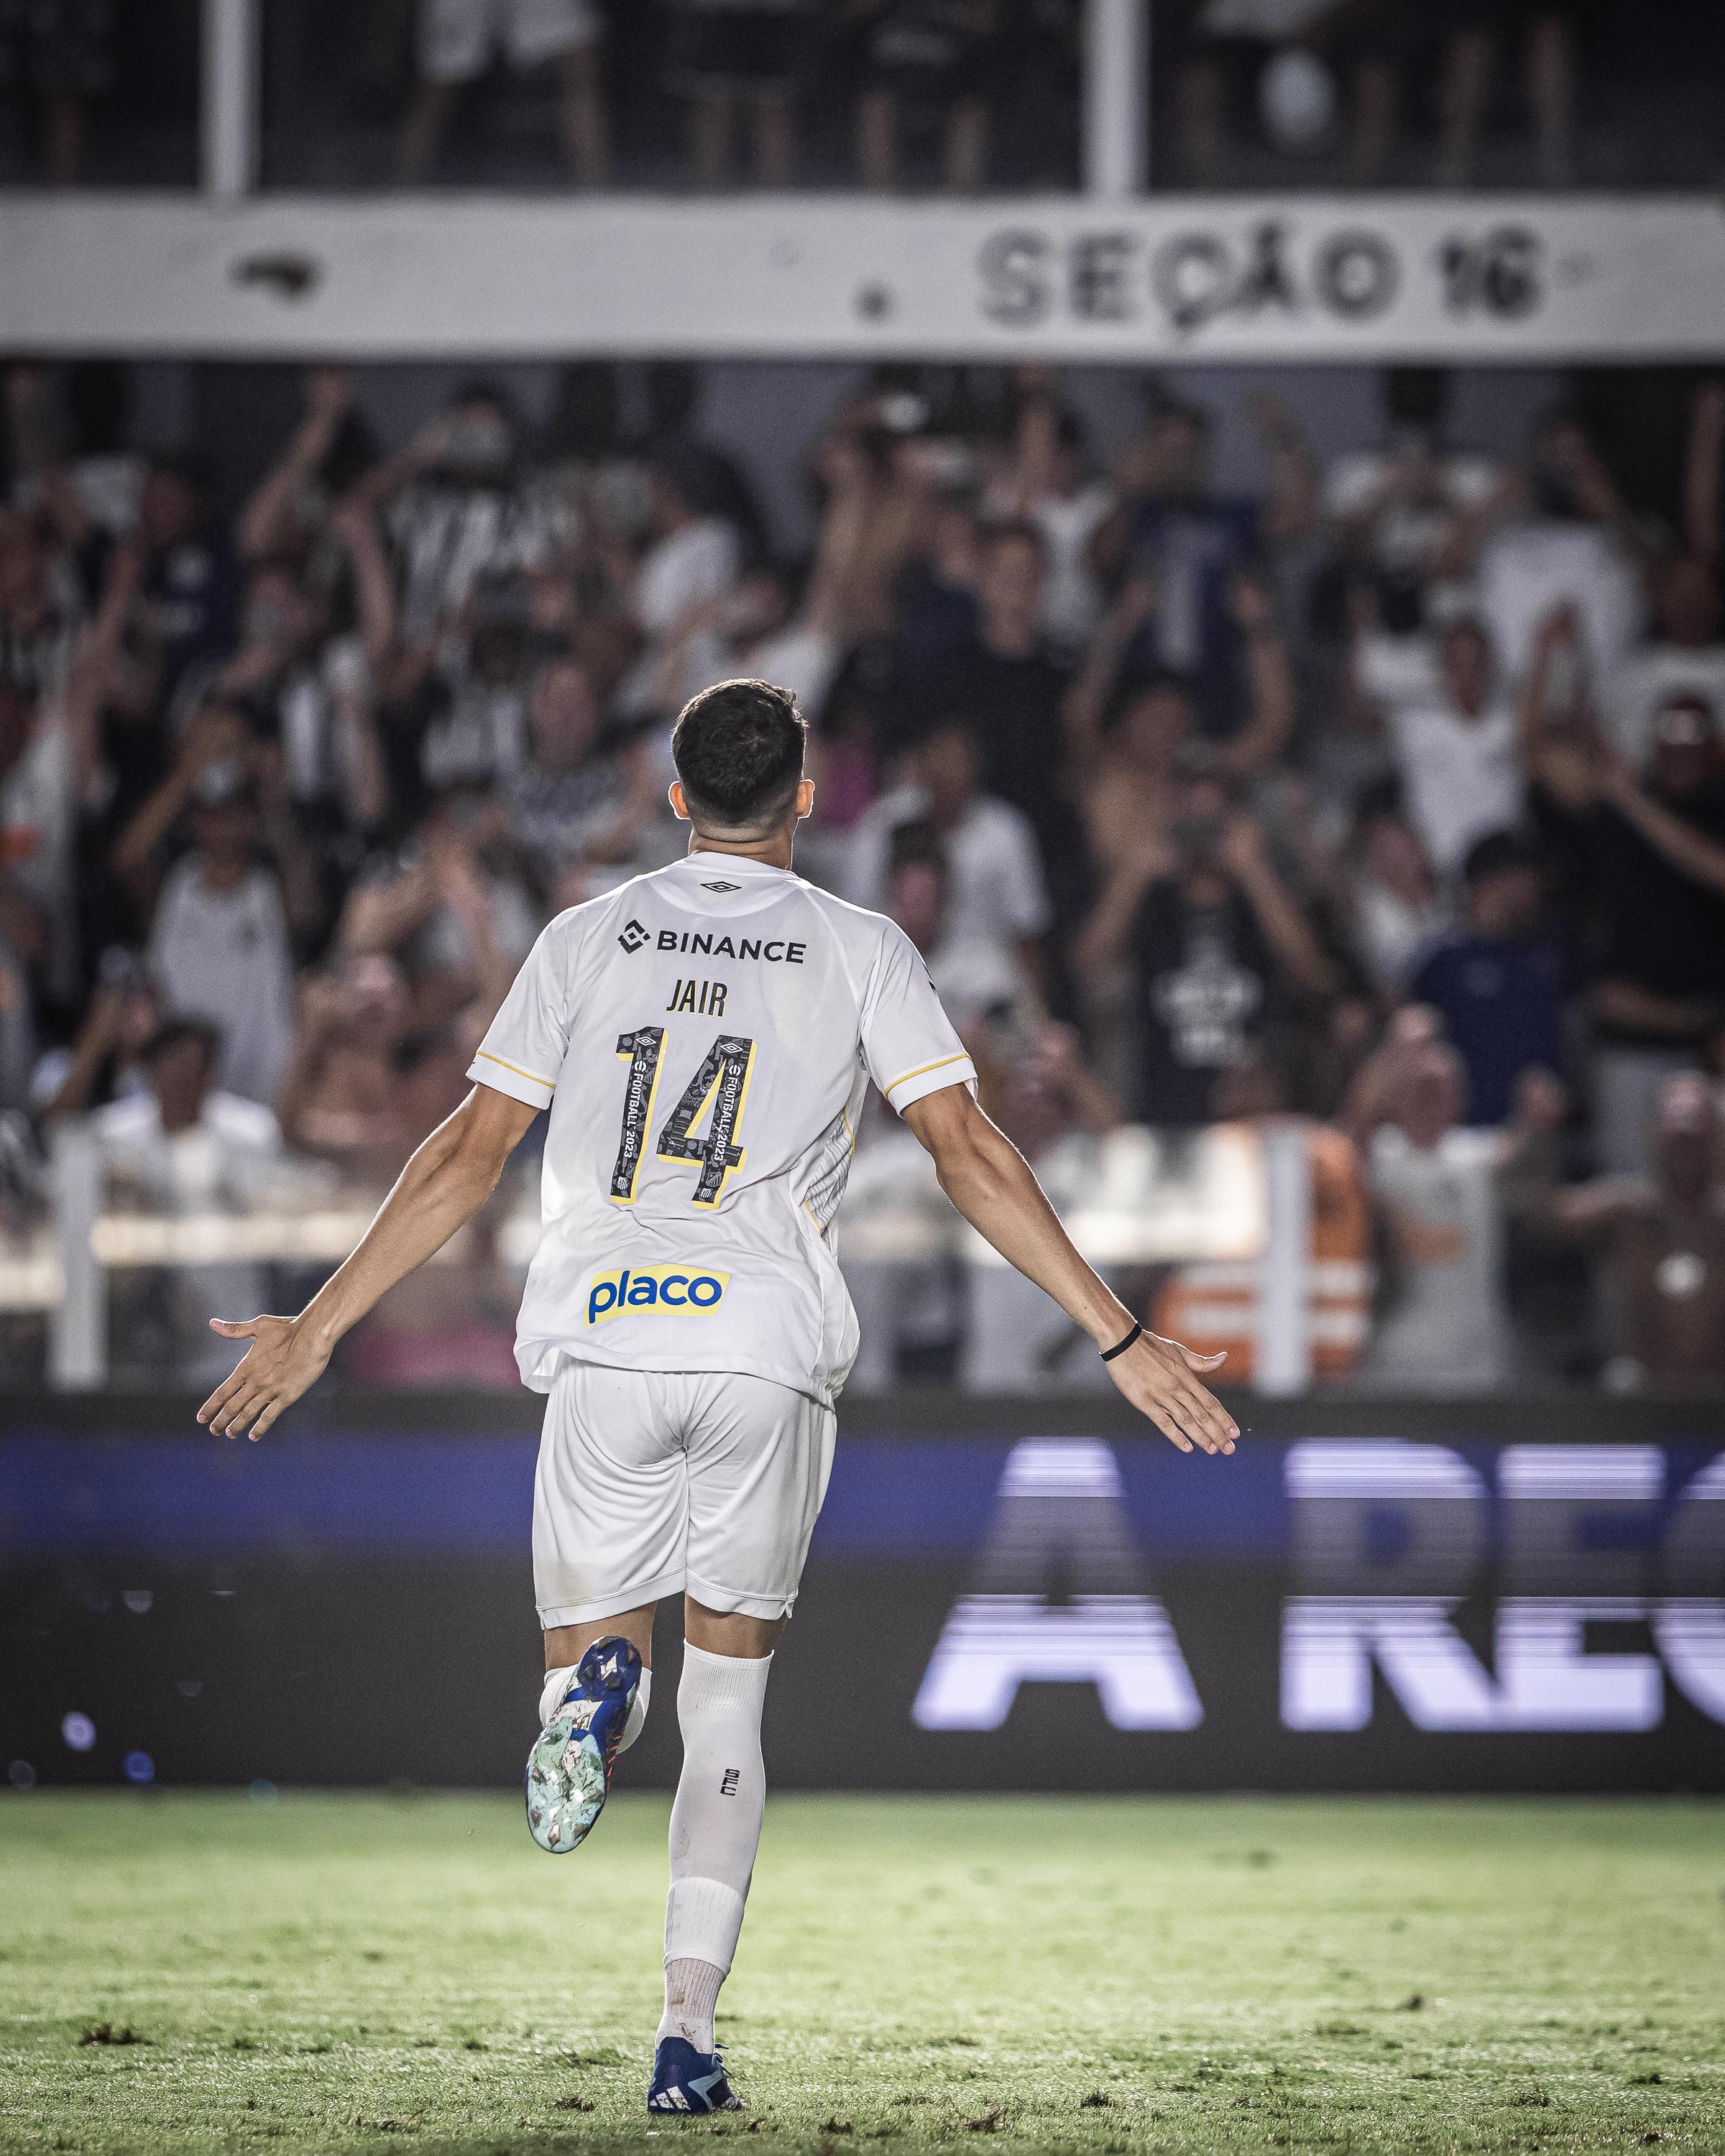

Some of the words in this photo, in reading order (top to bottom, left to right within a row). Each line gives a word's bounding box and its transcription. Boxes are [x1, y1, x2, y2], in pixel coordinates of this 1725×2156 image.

[975, 221, 1402, 339] SEÇÃO
[657, 931, 806, 964] BINANCE
[666, 980, 729, 1018] JAIR
[610, 1026, 757, 1210] 14
[624, 1130, 635, 1158] 2023
[714, 1133, 728, 1161] 2023
[589, 1271, 722, 1324] placo
[911, 1437, 1205, 1731] A
[720, 1769, 740, 1796] SFC
